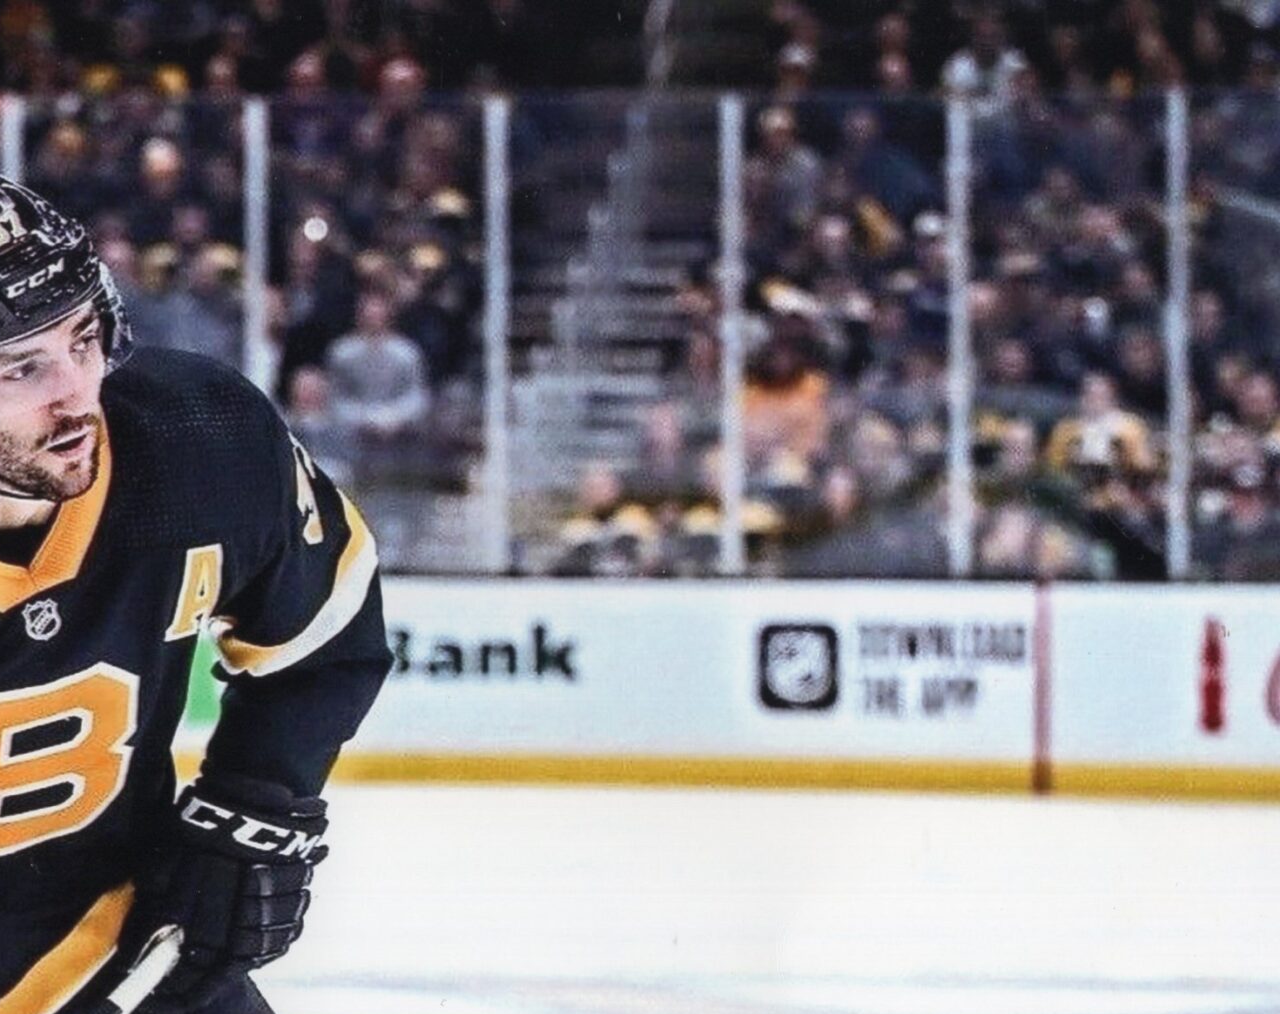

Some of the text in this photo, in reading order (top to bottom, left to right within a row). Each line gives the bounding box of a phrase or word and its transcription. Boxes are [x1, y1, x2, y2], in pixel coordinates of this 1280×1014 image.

[6, 257, 65, 299] CCM
[164, 543, 223, 642] A
[180, 796, 324, 862] CCM
